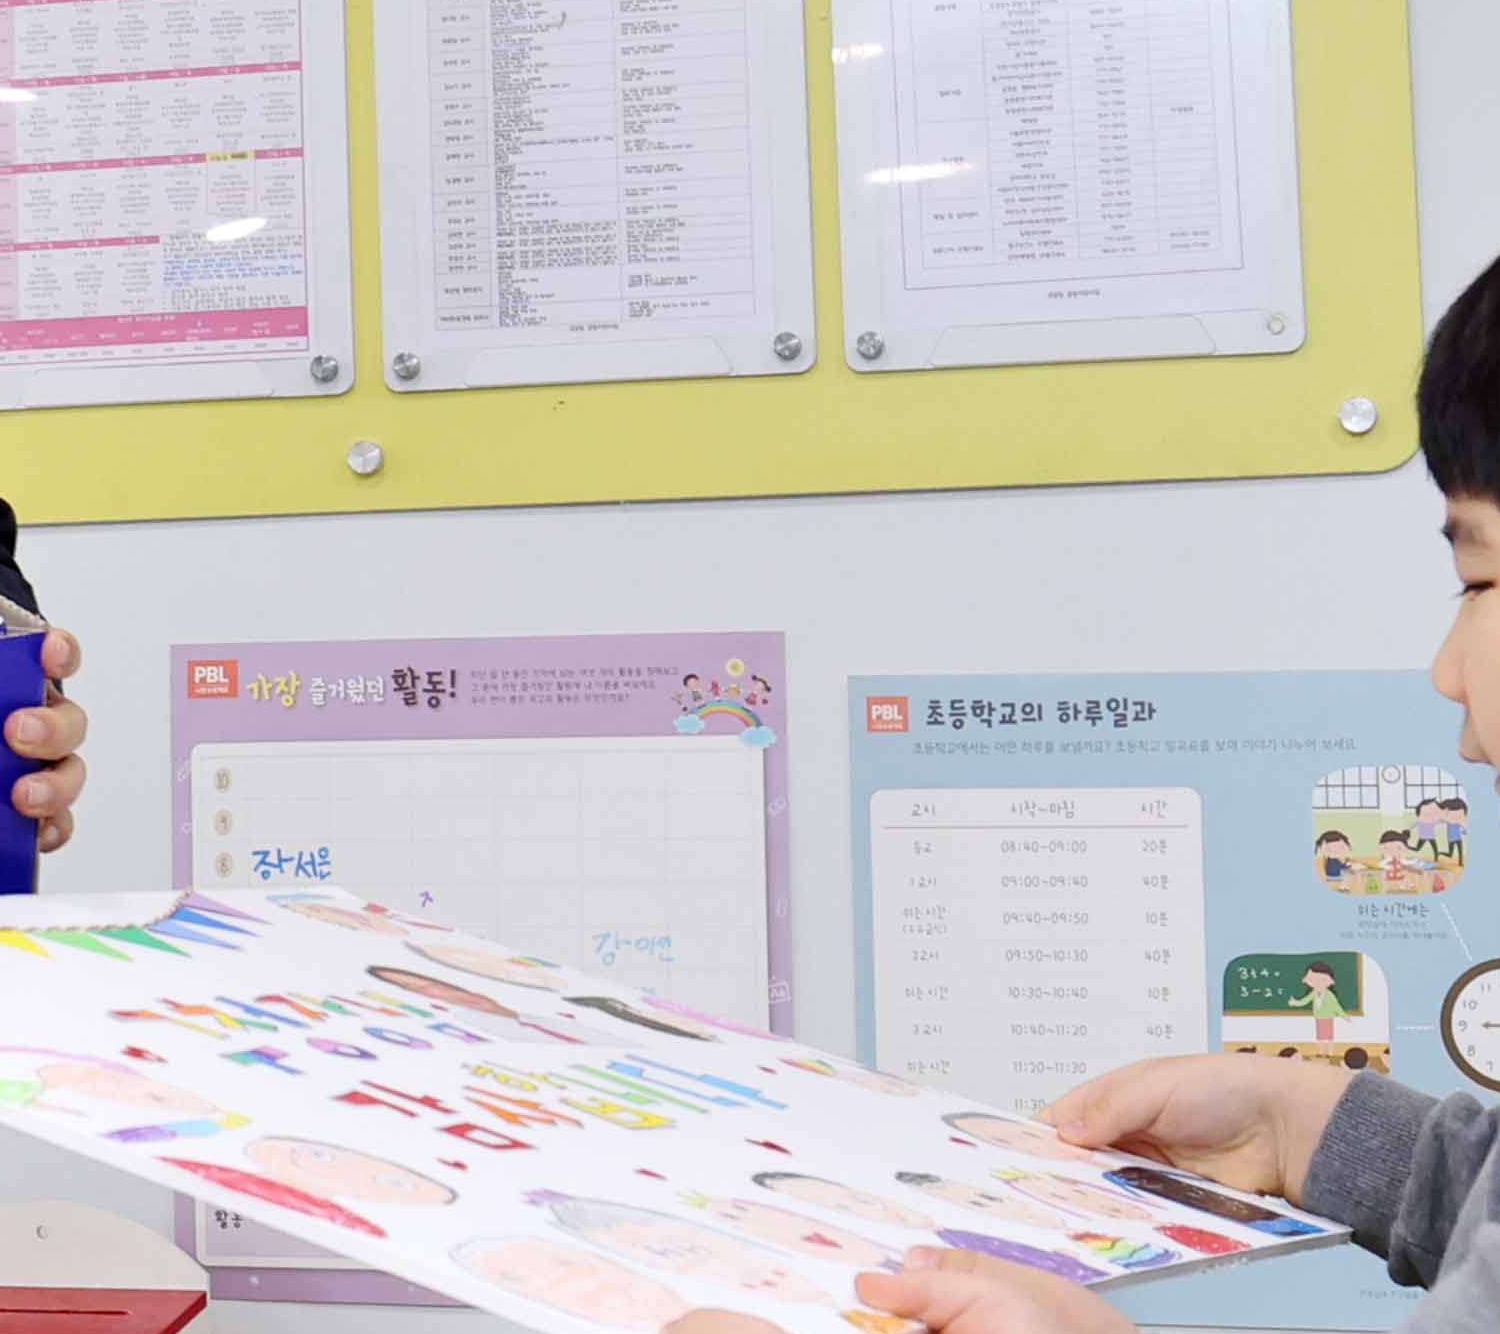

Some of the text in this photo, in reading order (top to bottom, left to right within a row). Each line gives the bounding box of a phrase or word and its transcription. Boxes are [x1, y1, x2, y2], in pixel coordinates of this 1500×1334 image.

[194, 667, 229, 684] PBL
[247, 666, 458, 709] 가장 즐거웠던 활동!
[870, 703, 904, 722] PBL
[924, 696, 1158, 730] 초등학교의 하루일과
[333, 1053, 788, 1151] 감사합니다
